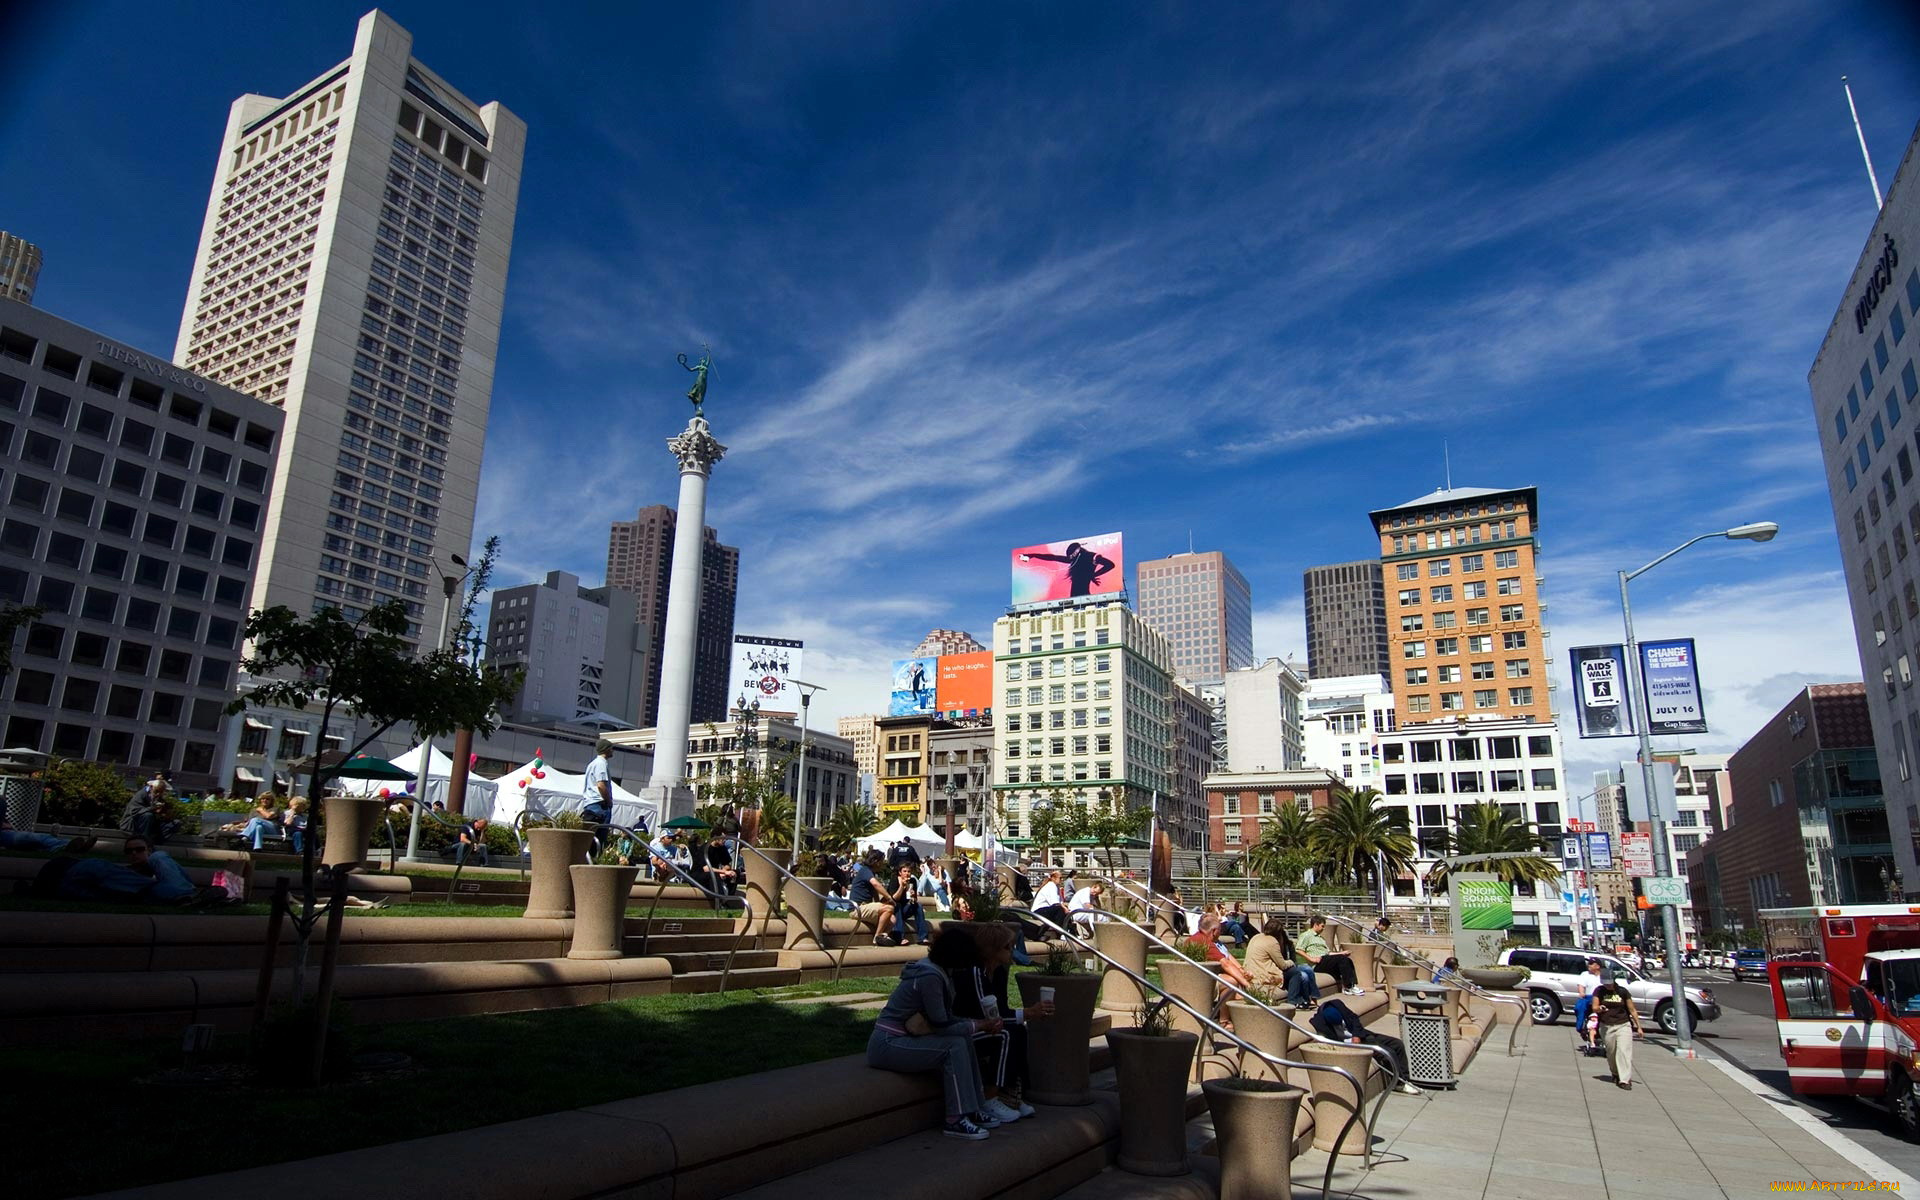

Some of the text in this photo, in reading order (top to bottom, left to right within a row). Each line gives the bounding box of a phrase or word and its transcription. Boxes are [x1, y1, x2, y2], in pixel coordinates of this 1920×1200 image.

[97, 341, 167, 377] TIFFANY
[169, 370, 180, 384] &
[738, 638, 800, 647] NIKETOWN
[1647, 647, 1687, 658] CHANGE
[1587, 662, 1611, 671] AIDS
[1587, 670, 1612, 678] WALK
[744, 680, 786, 691] BEWRE
[1462, 887, 1496, 895] UNION
[1463, 895, 1504, 903] SQUARE
